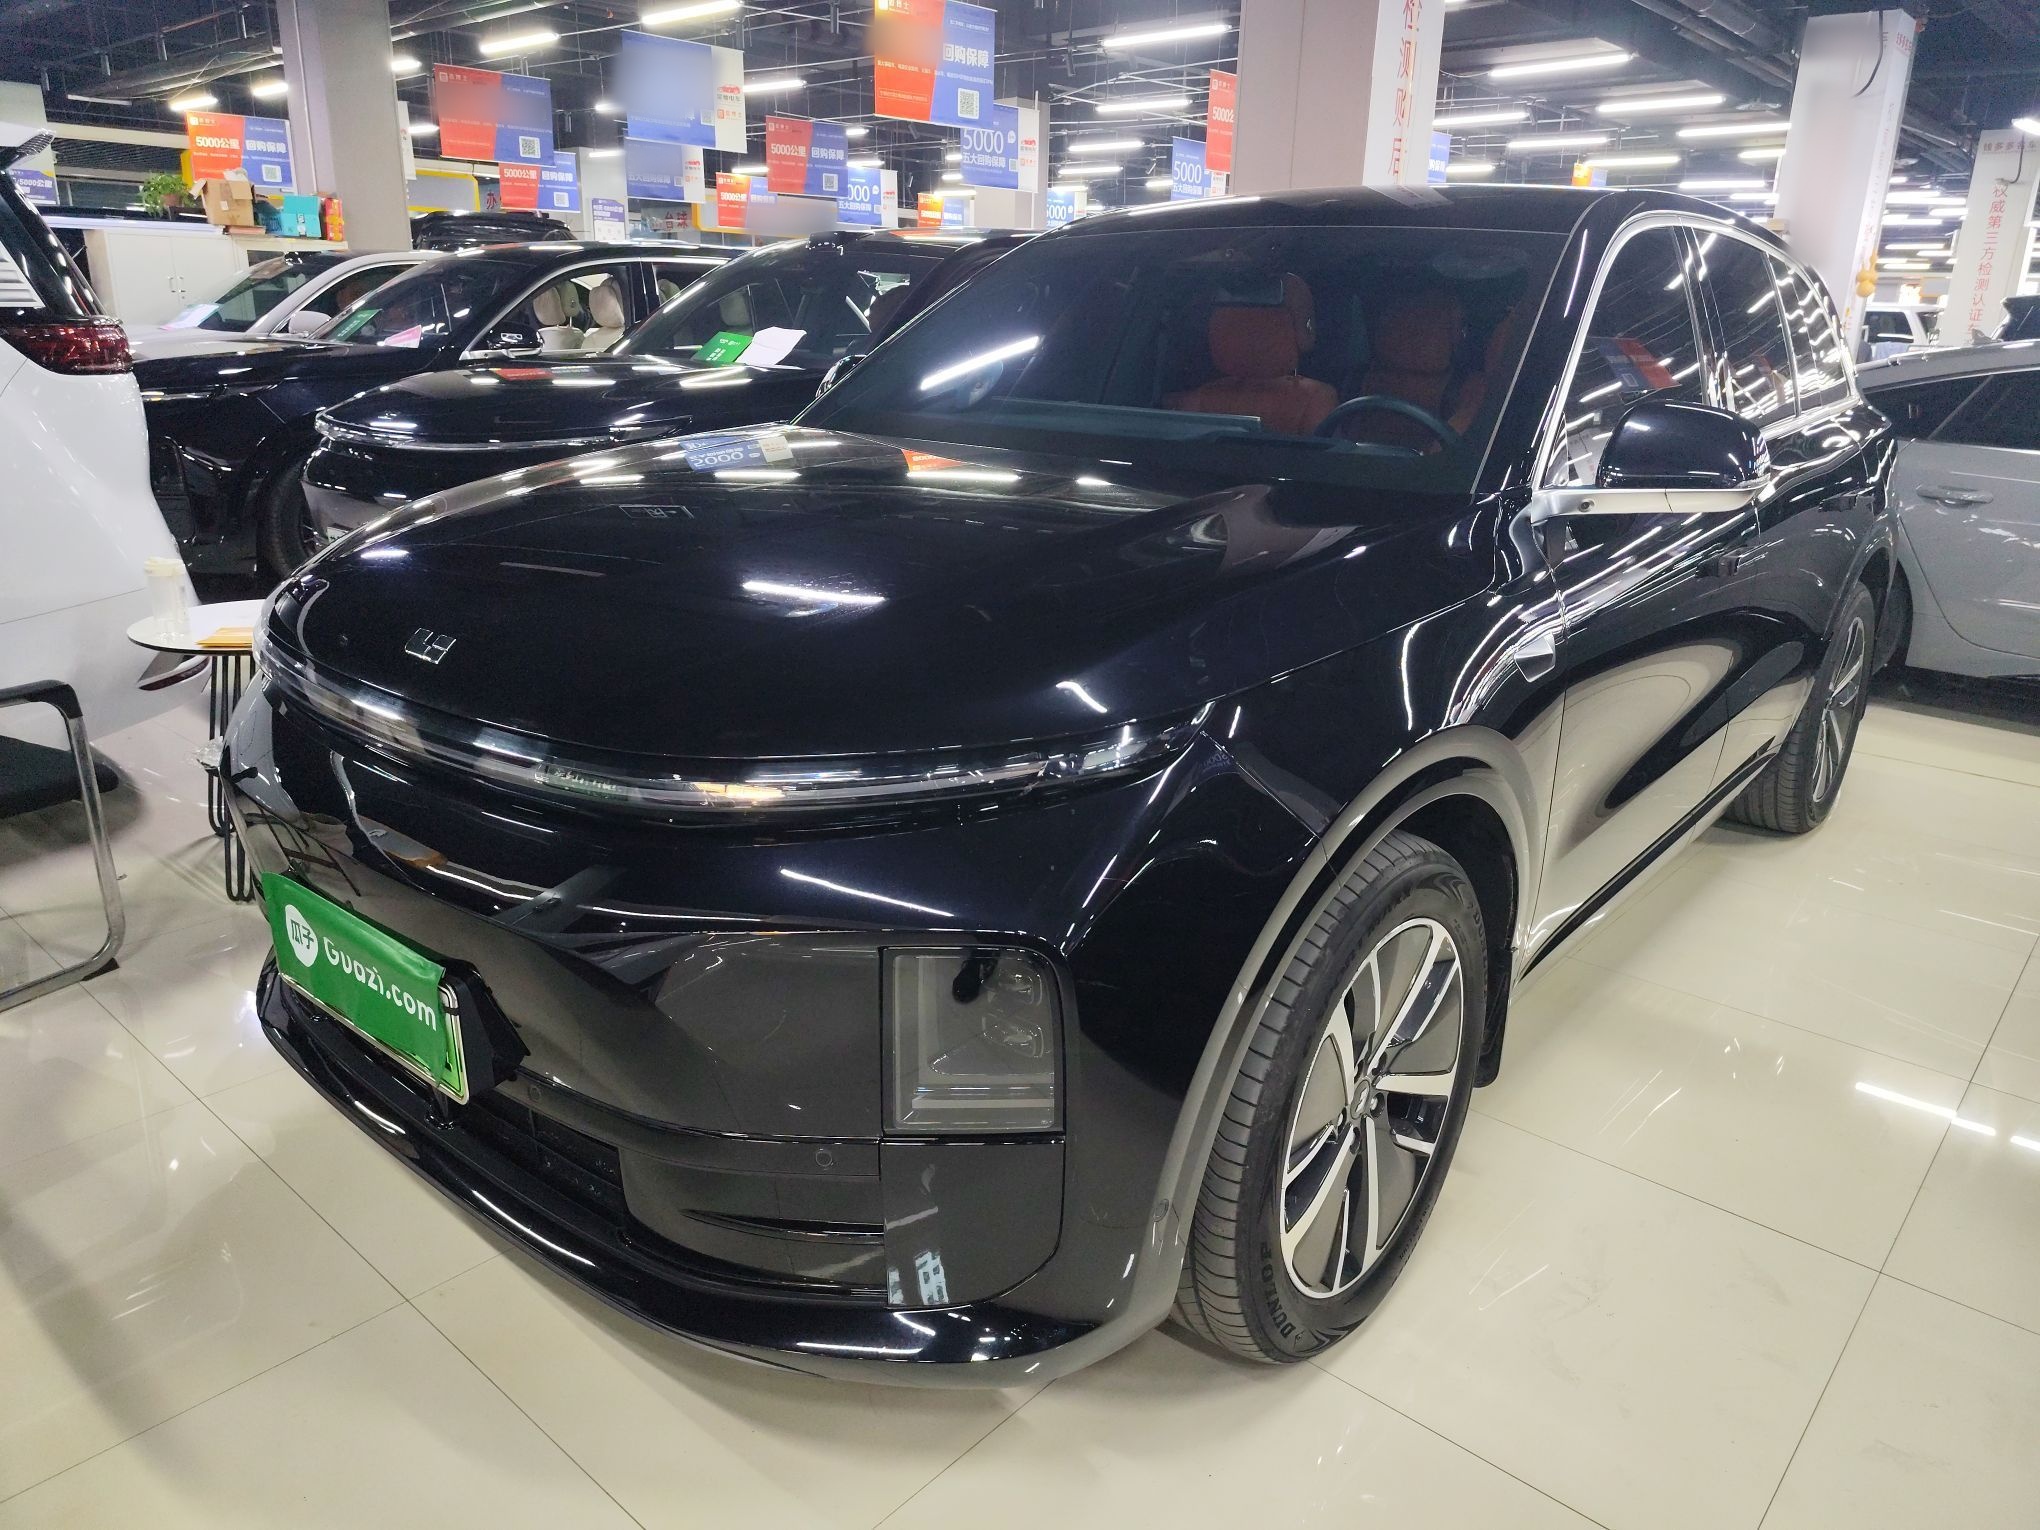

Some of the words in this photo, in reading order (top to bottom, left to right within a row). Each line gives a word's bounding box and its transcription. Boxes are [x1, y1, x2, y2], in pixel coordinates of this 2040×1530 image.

[943, 43, 990, 68] 回购保障
[195, 136, 240, 150] 5000公里
[245, 139, 287, 153] 回购保障
[962, 130, 1004, 154] 5000
[770, 143, 806, 157] 5000公里
[811, 147, 845, 161] 回购保障
[962, 152, 1006, 168] 五大回购保障
[503, 168, 537, 180] 5000公里
[1173, 160, 1202, 183] 5000
[720, 191, 747, 203] 5000公里
[838, 200, 872, 212] 五大回购保障
[290, 919, 315, 950] 瓜子
[323, 936, 437, 1031] Guazi.com
[1260, 1242, 1297, 1339] DUNLOP
